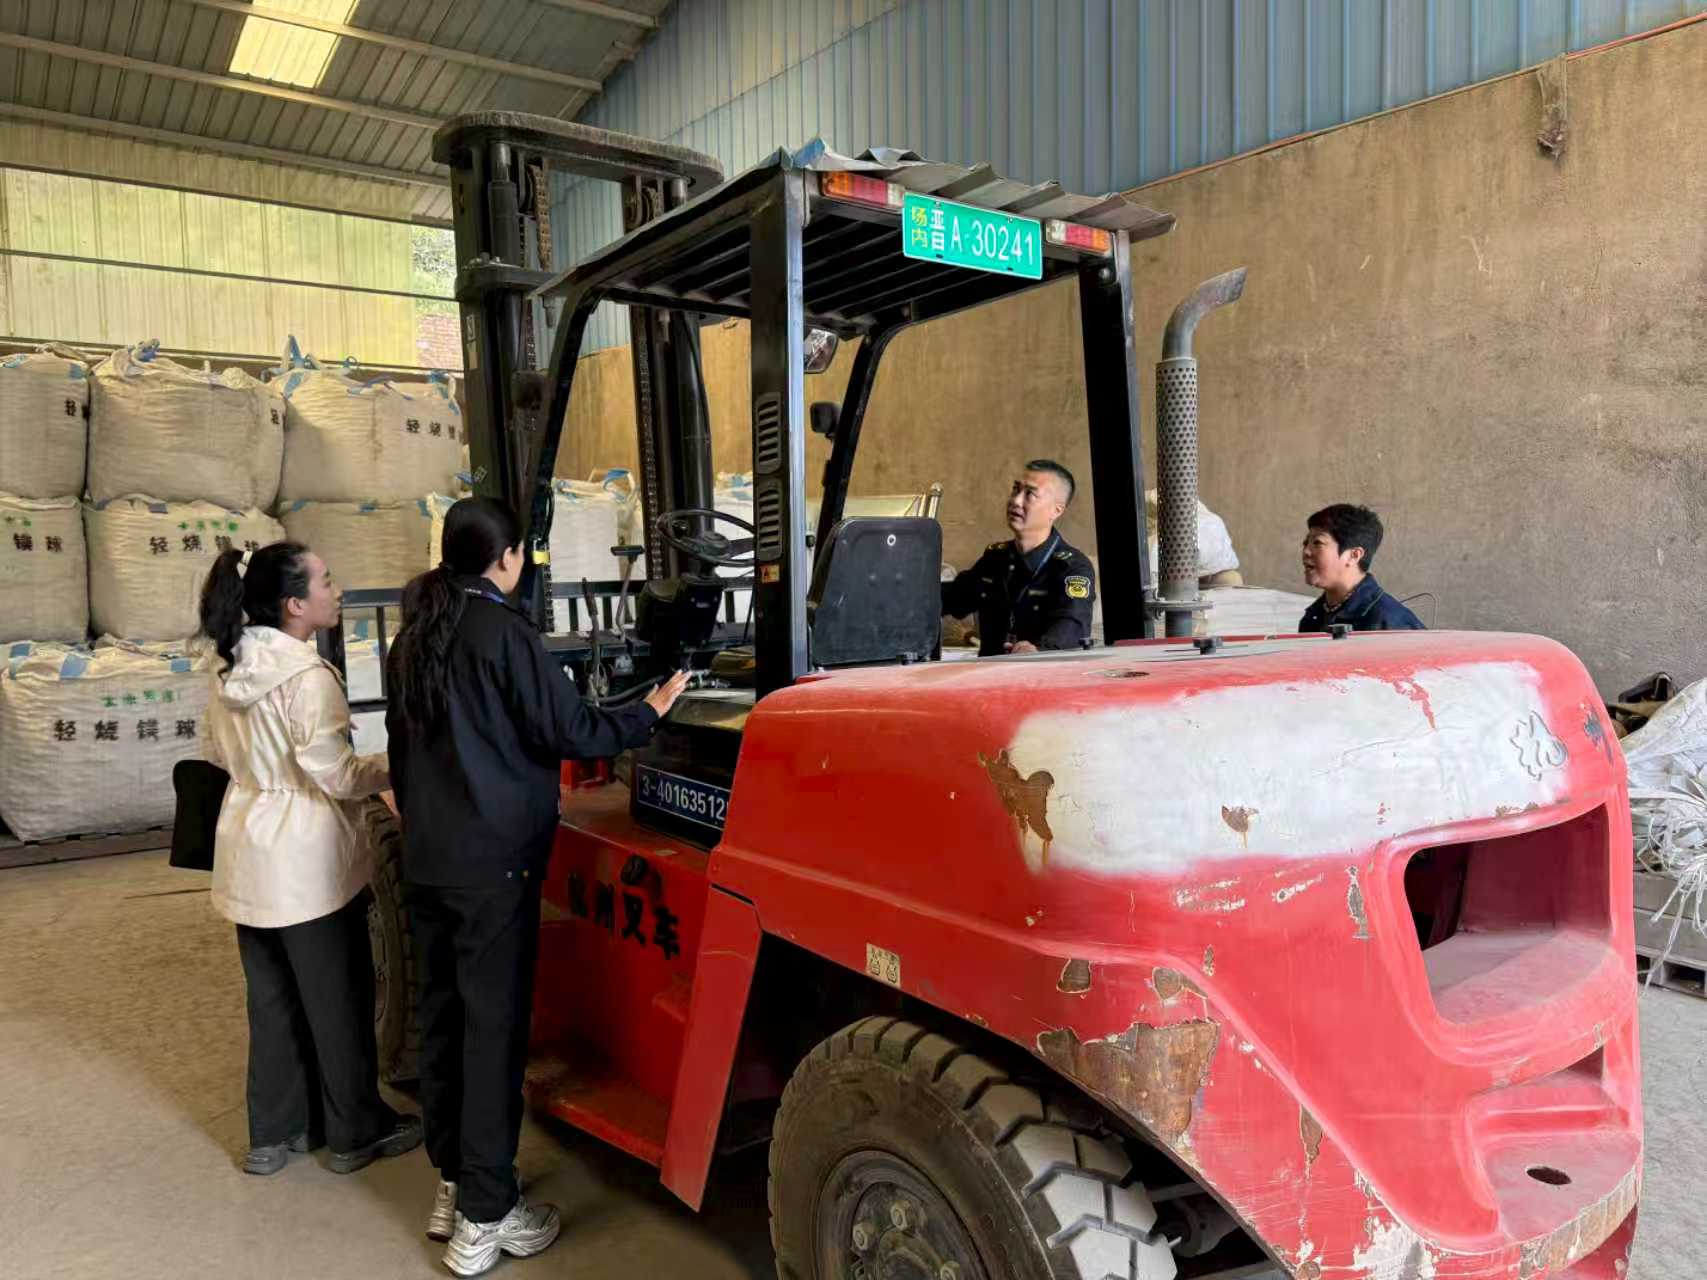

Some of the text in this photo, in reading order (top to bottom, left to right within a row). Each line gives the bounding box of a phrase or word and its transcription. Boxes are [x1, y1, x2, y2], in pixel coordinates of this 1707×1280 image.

[911, 206, 928, 249] 场内
[53, 718, 197, 742] 轻烧镁球
[641, 775, 730, 821] 3-40163512
